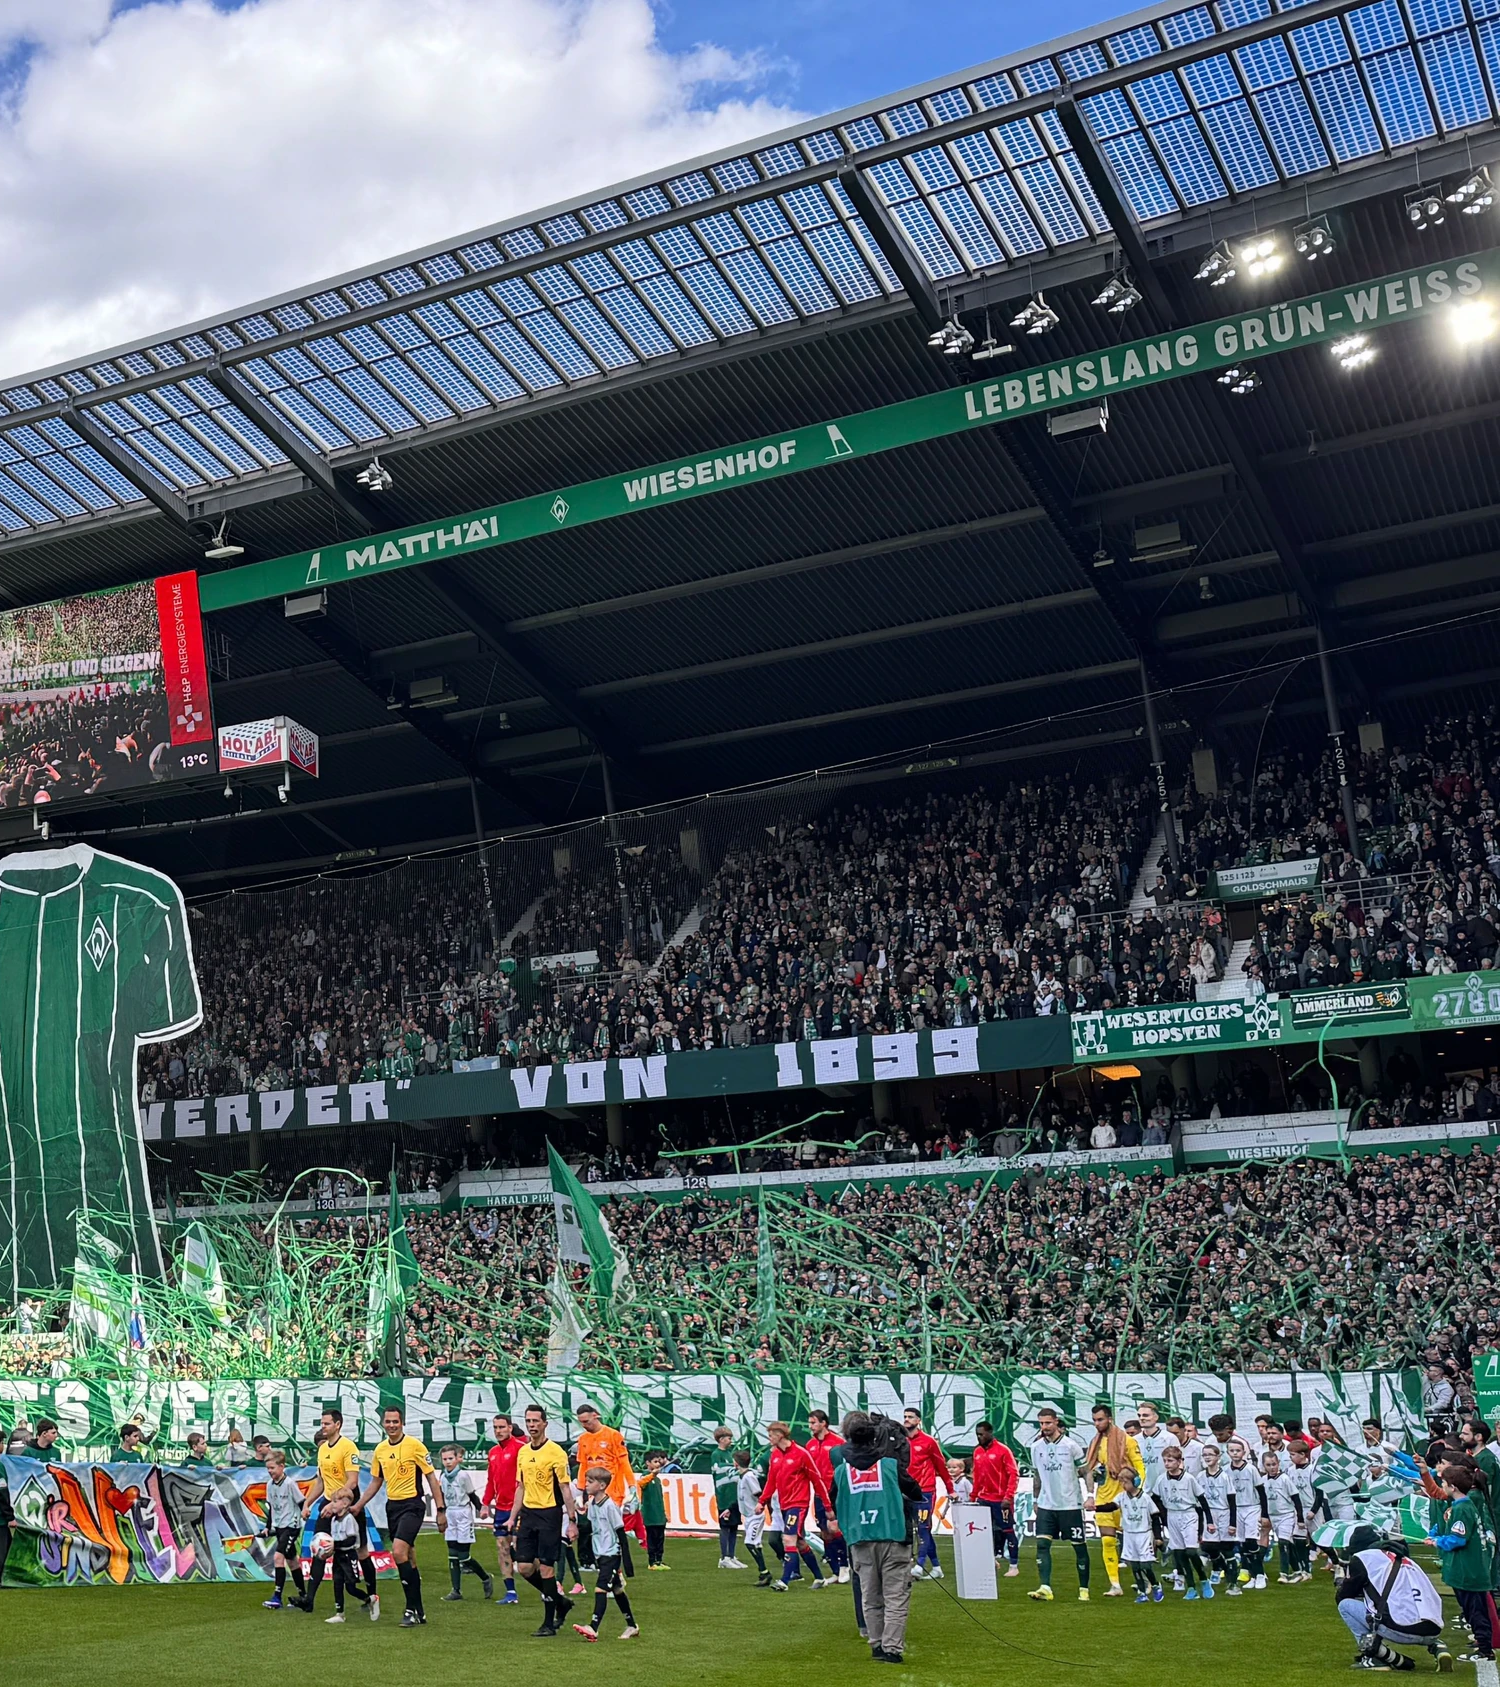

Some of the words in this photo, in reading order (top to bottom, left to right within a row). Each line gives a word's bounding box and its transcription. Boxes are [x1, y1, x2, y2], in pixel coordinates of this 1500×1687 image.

[965, 326, 1200, 422] LEBENSLANG
[1214, 260, 1483, 357] GRÜN-WEISS
[623, 439, 798, 503] WIESENHOF
[345, 515, 499, 572] MATTHÄI
[171, 582, 191, 675] ENERGIESYSTEME
[183, 677, 192, 702] H&P
[180, 753, 208, 769] 13°C
[1232, 876, 1309, 893] GOLDSCHMAUS
[1105, 1002, 1244, 1030] WESERTIGERS
[1295, 994, 1374, 1015] AMMERLAND
[1132, 1023, 1222, 1046] HOPSTEN
[510, 1055, 667, 1109] VON
[774, 1025, 980, 1089] 1899
[684, 1177, 706, 1189] 128
[487, 1194, 529, 1206] HARALD
[106, 1378, 383, 1443] WERDER
[786, 1514, 799, 1526] 13
[860, 1509, 879, 1525] 17
[1071, 1527, 1083, 1539] 32
